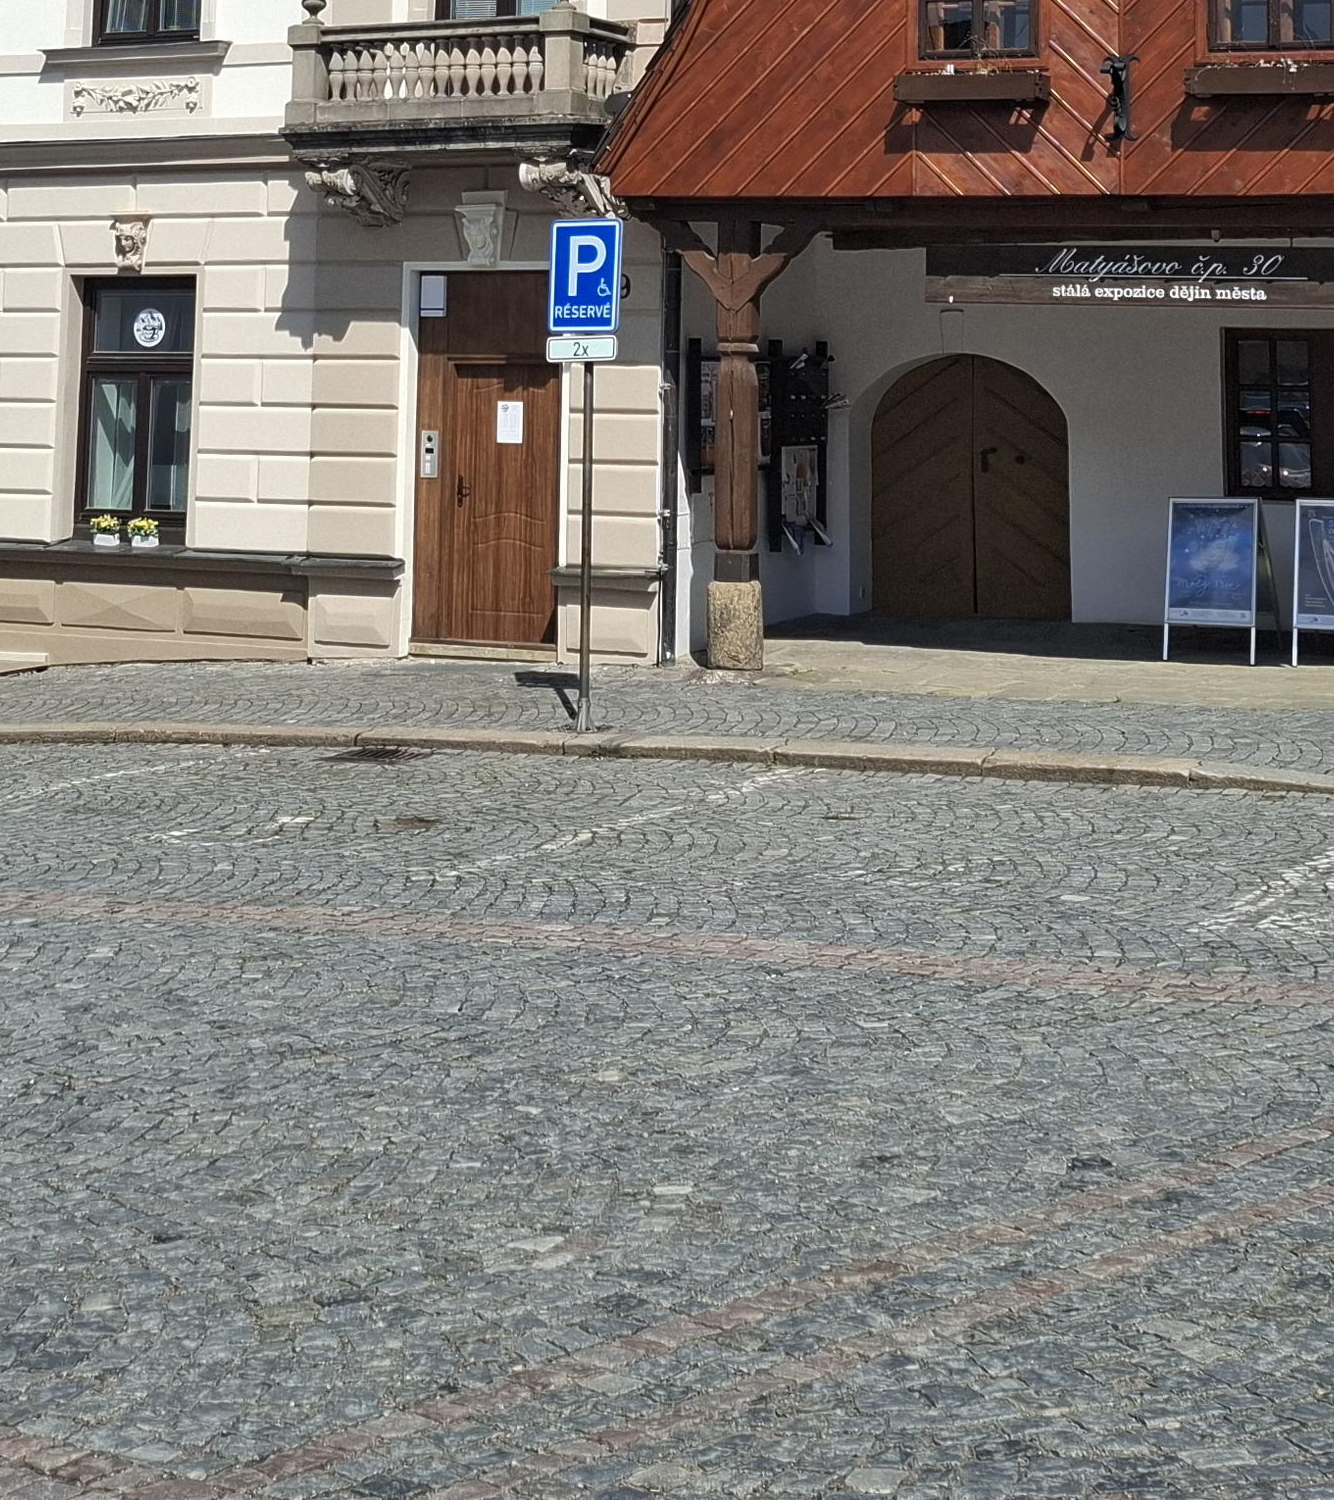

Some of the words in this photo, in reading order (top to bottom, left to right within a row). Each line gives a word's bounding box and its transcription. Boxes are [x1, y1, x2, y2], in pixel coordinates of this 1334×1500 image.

[568, 235, 606, 297] P
[1034, 248, 1182, 283] Matyášovo
[1242, 254, 1285, 276] 30
[1052, 284, 1091, 298] stálá
[1094, 285, 1165, 301] expozice
[1169, 284, 1212, 301] dějin
[1215, 286, 1267, 301] města
[554, 302, 611, 319] RÉSERVÉ
[573, 341, 589, 357] 2x
